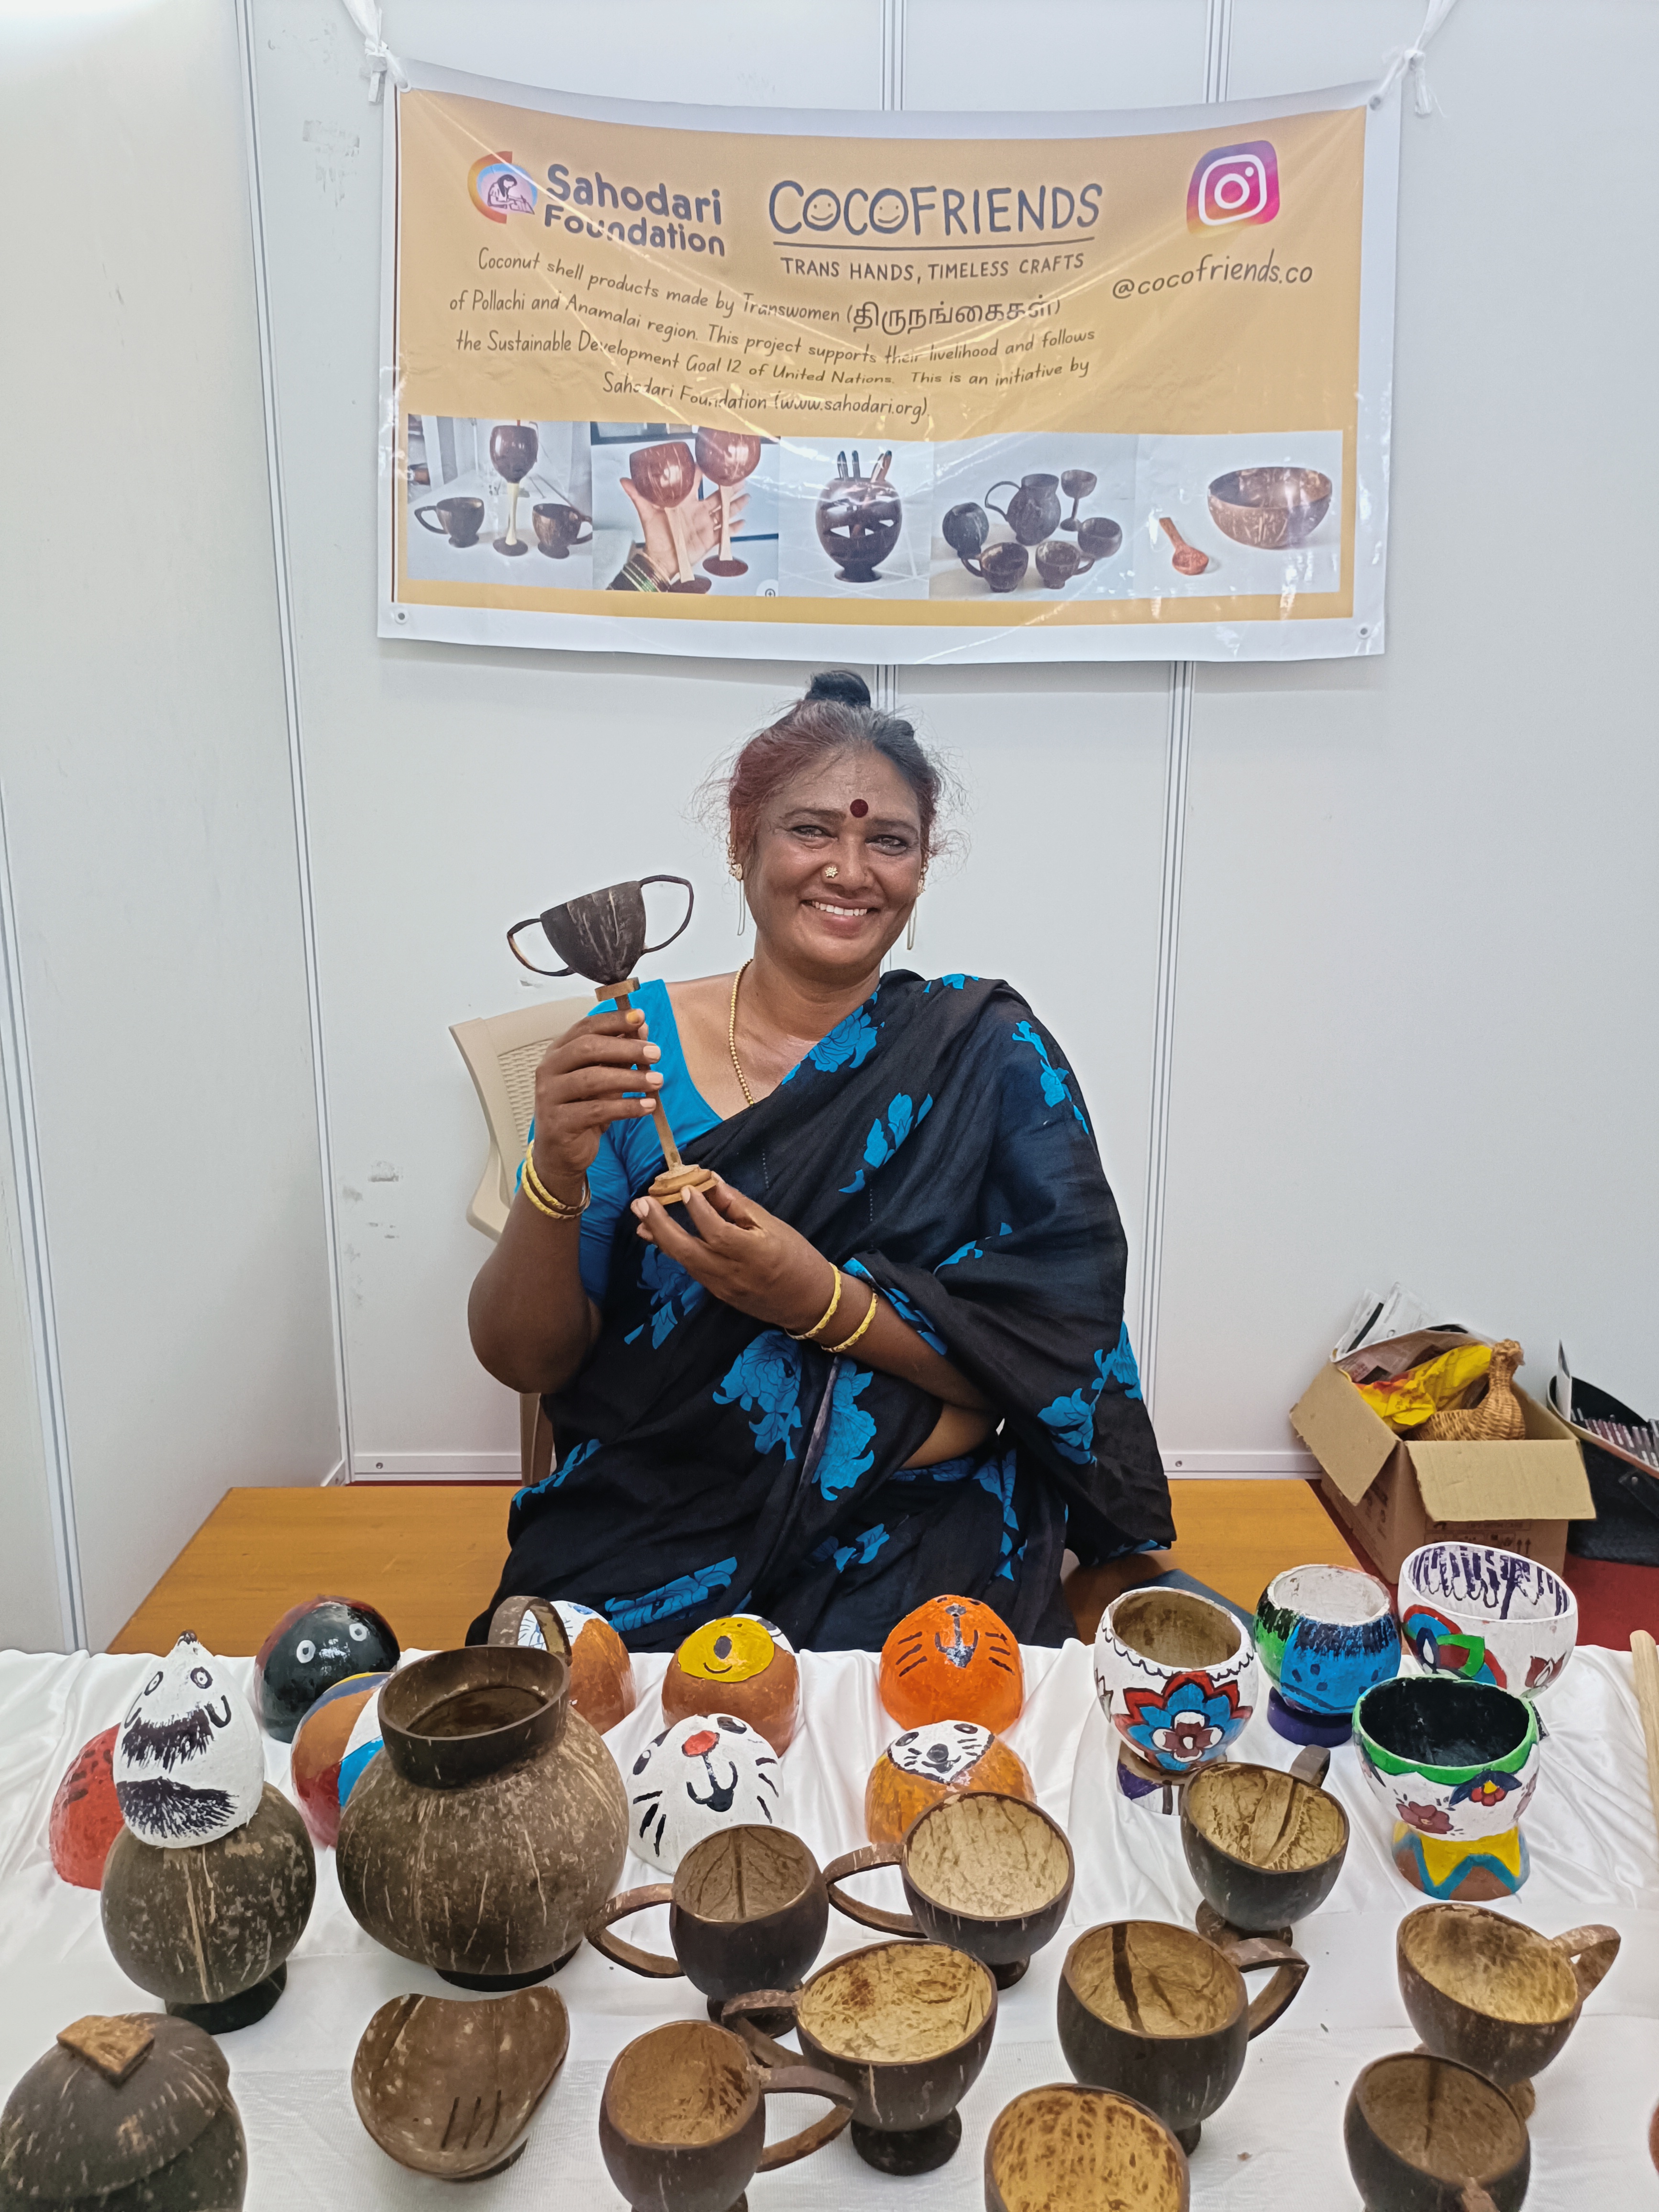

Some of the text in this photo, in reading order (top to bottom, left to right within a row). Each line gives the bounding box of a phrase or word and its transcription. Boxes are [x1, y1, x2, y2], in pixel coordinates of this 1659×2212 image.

[546, 164, 721, 225] Sahodari
[769, 180, 1103, 235] COCOFRIENDS
[544, 204, 725, 256] Foundation
[478, 247, 840, 322] Coconut shell products made by Transwomen
[780, 253, 1084, 284] TRANS HANDS, TIMELESS CRAFTS
[1112, 248, 1313, 299] @cocofriends.co
[450, 290, 1095, 365] of Pollachi and Anamalai region. This project supports their livelihood and follows
[456, 330, 1089, 386] the Sustainable Development Goal 12 of United Nations. This is an initiative by
[603, 371, 675, 398] Sahodari
[680, 385, 766, 409] Foundation
